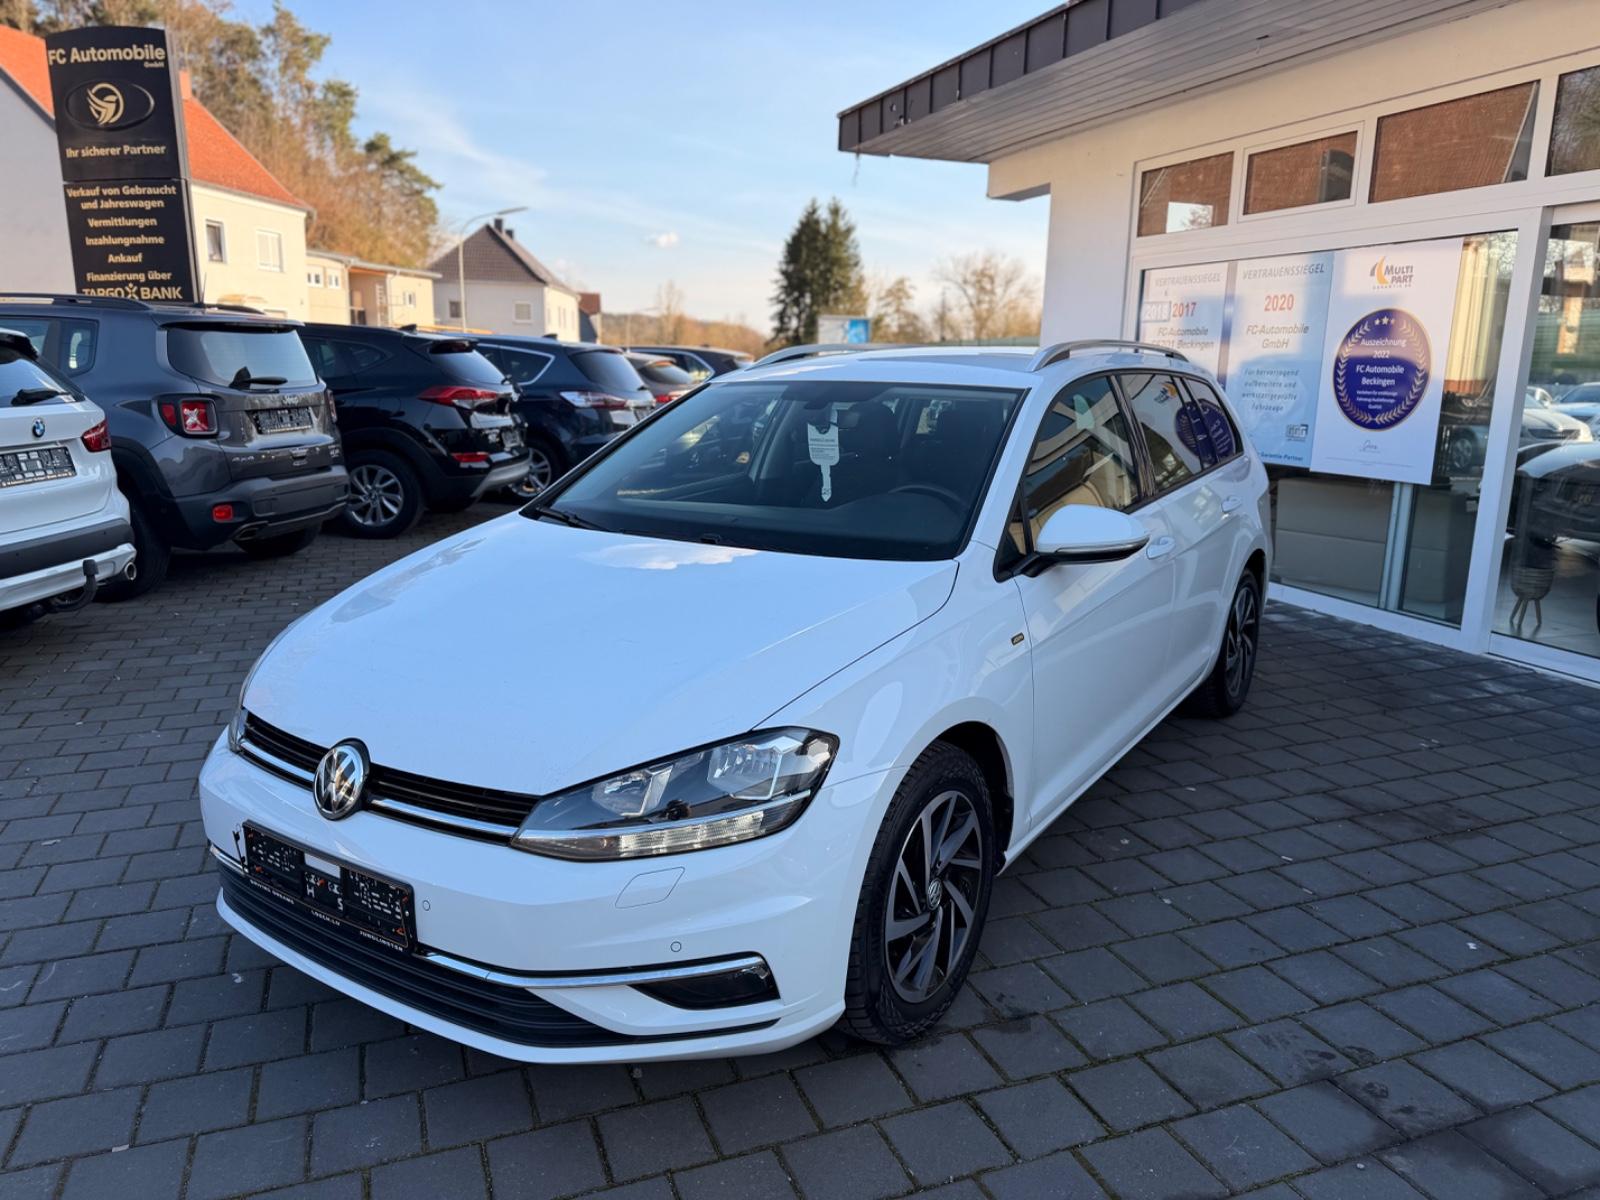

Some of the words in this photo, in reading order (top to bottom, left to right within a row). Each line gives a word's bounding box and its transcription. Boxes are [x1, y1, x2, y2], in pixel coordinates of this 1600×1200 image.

[48, 48, 67, 65] FC
[70, 44, 166, 63] Automobile
[66, 148, 78, 158] Ihr
[81, 146, 121, 157] sicherer
[123, 145, 166, 155] Partner
[67, 186, 100, 197] Verkauf
[102, 187, 120, 195] von
[122, 185, 177, 195] Gebraucht
[81, 200, 98, 209] und
[100, 198, 165, 210] Jahreswagen
[87, 217, 158, 228] Vermittlungen
[85, 234, 165, 246] Inzahlungnahme
[108, 252, 143, 263] Ankauf
[86, 271, 145, 282] Finanzierung
[148, 270, 172, 281] über
[1391, 274, 1414, 284] PART
[1264, 293, 1295, 312] 2020
[1172, 301, 1198, 318] 2017
[1360, 338, 1408, 347] Auszeichnung
[1355, 364, 1364, 373] FC
[1365, 364, 1405, 374] Automobile
[1361, 377, 1396, 387] Beckingen
